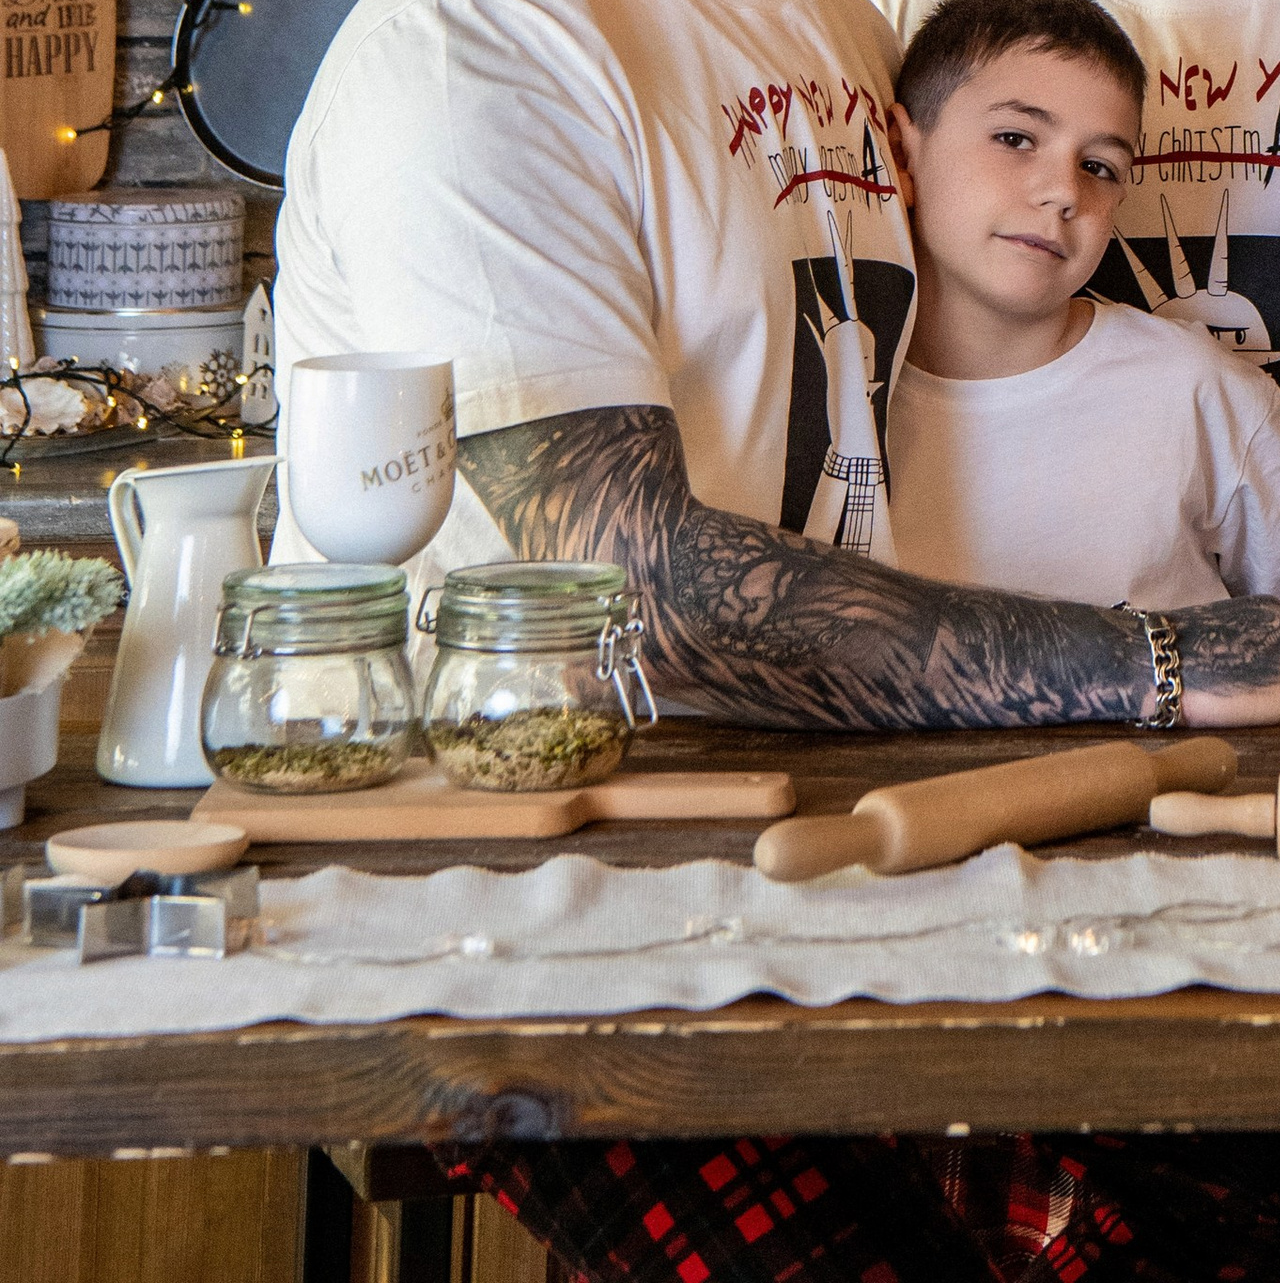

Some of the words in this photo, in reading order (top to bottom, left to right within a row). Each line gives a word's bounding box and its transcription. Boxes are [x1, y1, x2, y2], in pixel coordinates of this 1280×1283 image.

[6, 3, 50, 29] and
[6, 31, 99, 79] HAPPY
[1160, 56, 1237, 111] NEW
[360, 445, 431, 492] MOËT
